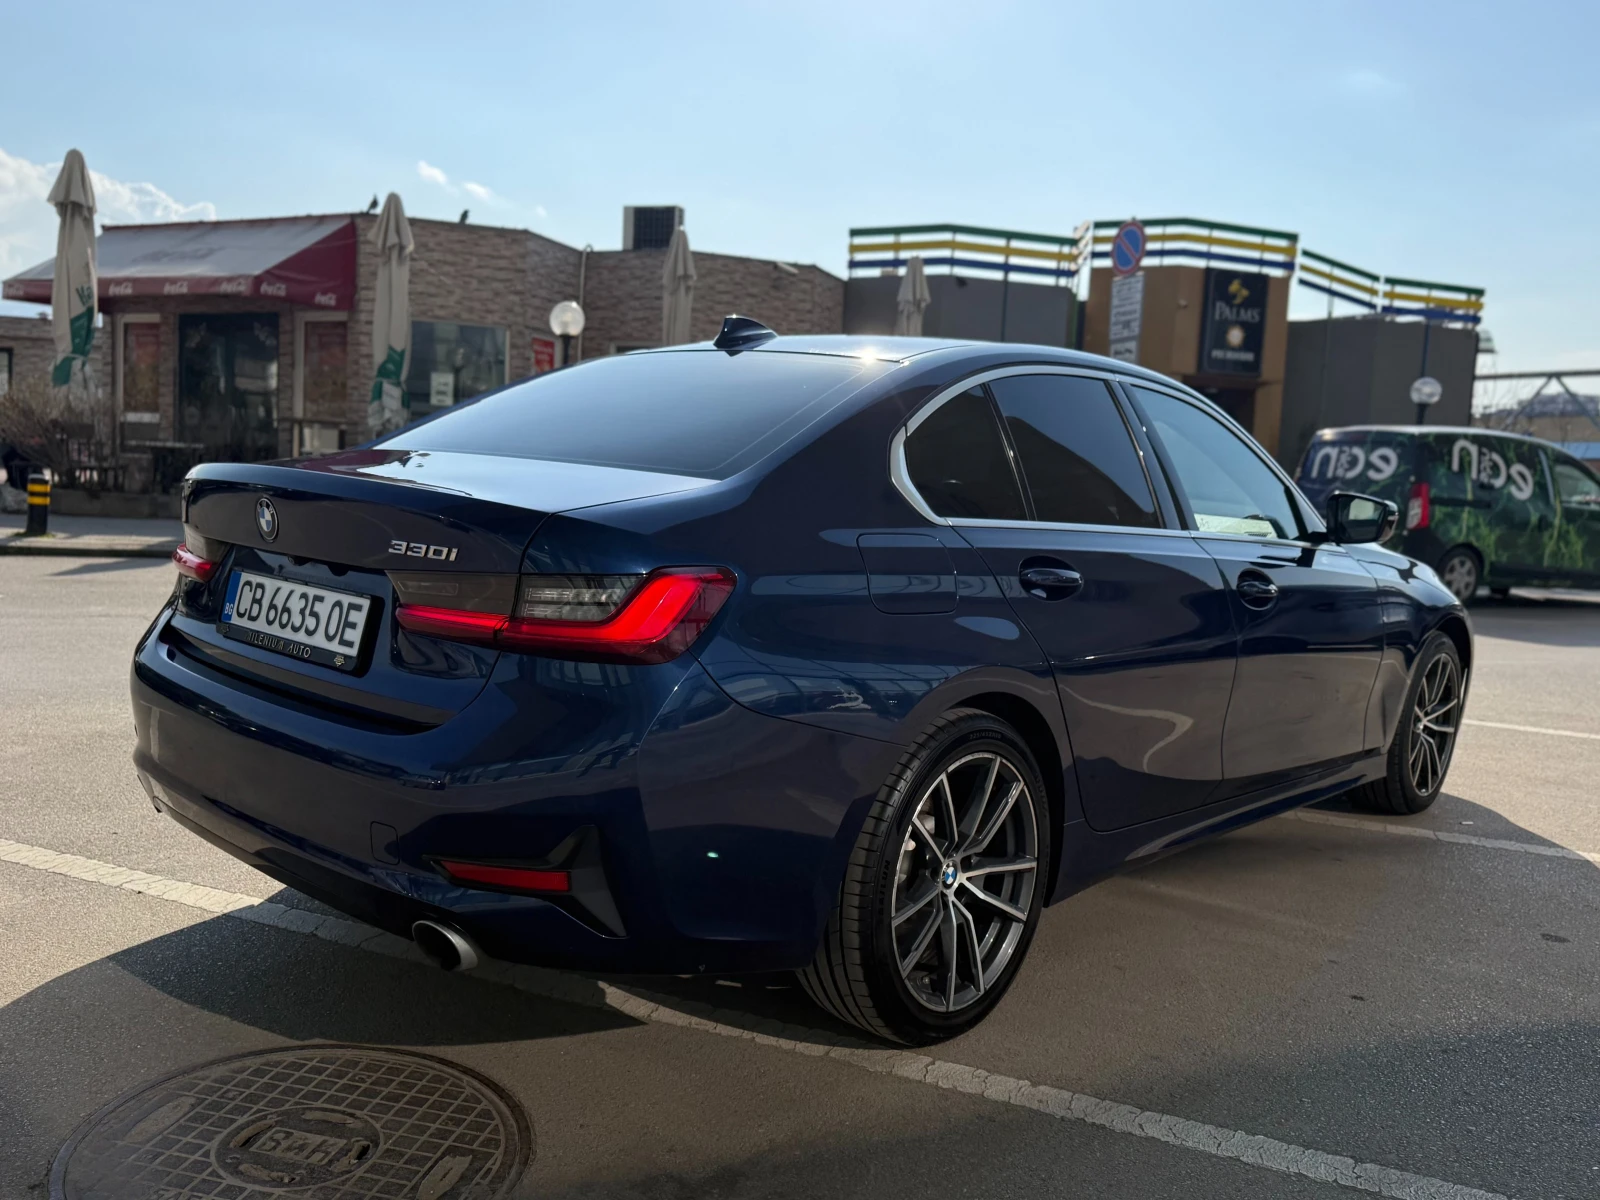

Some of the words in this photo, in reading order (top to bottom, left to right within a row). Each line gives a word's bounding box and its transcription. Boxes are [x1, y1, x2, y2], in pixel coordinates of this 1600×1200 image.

[1214, 301, 1261, 322] PALMS
[388, 540, 459, 561] 330i
[224, 602, 234, 615] BG
[236, 580, 265, 622] CB
[266, 586, 325, 637] 6635
[288, 643, 311, 659] AUTO
